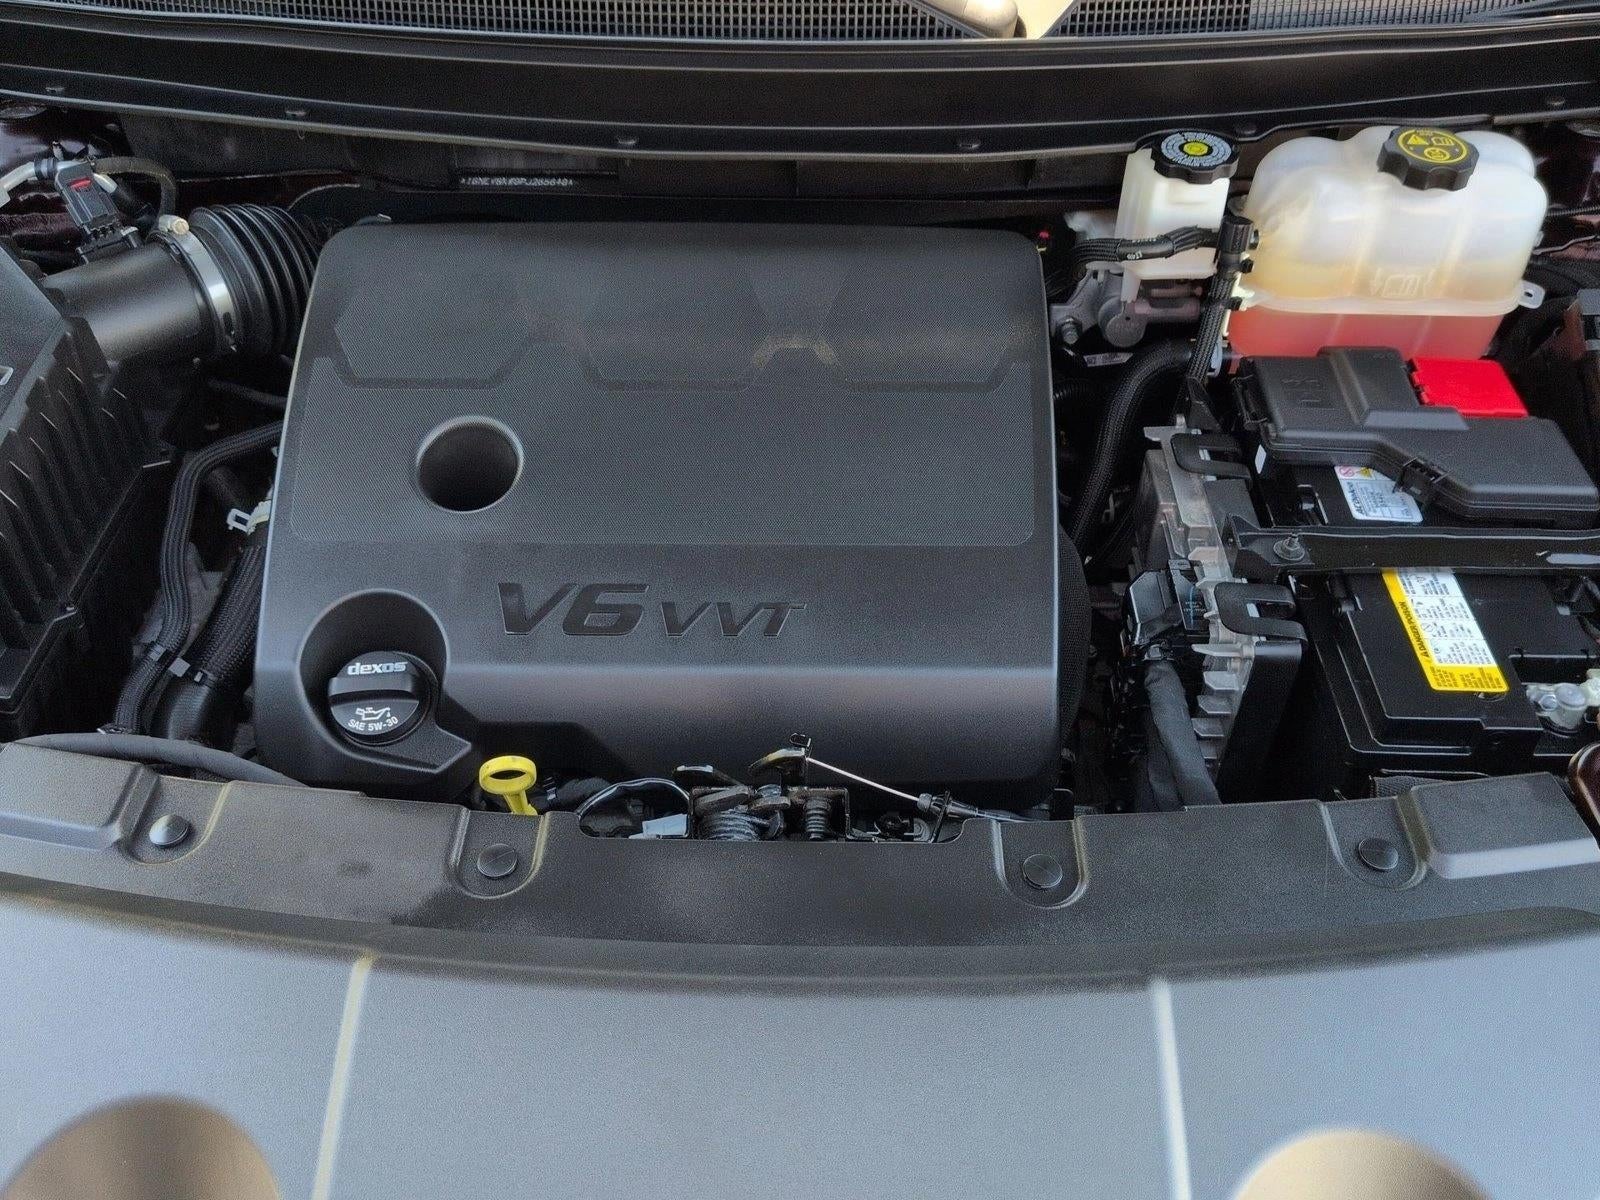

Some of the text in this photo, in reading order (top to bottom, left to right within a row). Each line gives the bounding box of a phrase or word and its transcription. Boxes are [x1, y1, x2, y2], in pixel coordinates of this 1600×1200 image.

[498, 582, 807, 637] V6 VVT
[347, 661, 408, 675] dexos
[348, 716, 399, 731] SAE 5W-30
